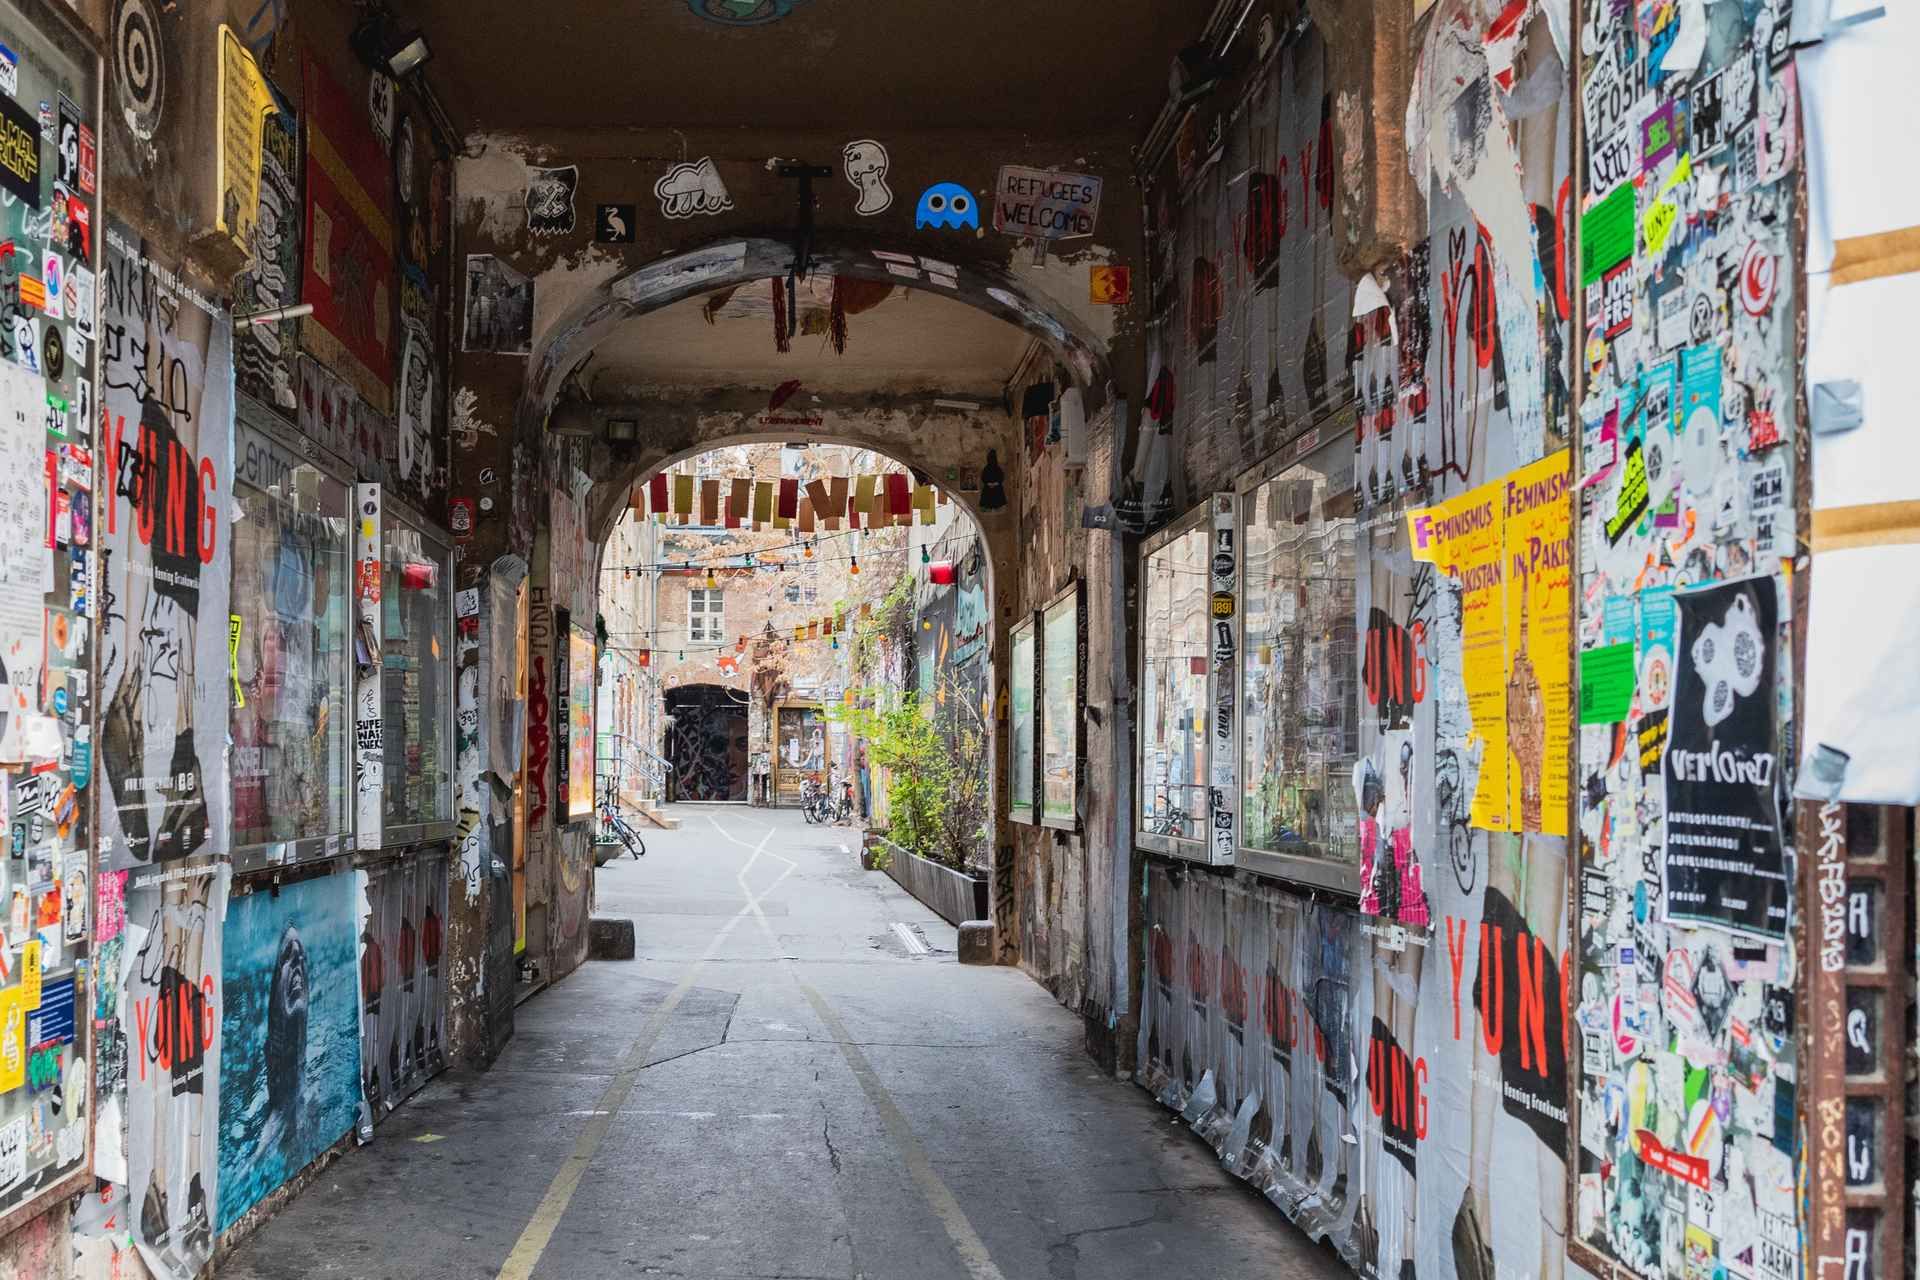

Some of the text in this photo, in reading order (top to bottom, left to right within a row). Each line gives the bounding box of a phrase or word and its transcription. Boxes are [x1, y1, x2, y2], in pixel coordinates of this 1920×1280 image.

[1008, 176, 1093, 204] REFUGEES
[1003, 203, 1093, 232] WELCOME
[1414, 500, 1493, 549] FEMINISMUS
[136, 974, 215, 1082] YUNG
